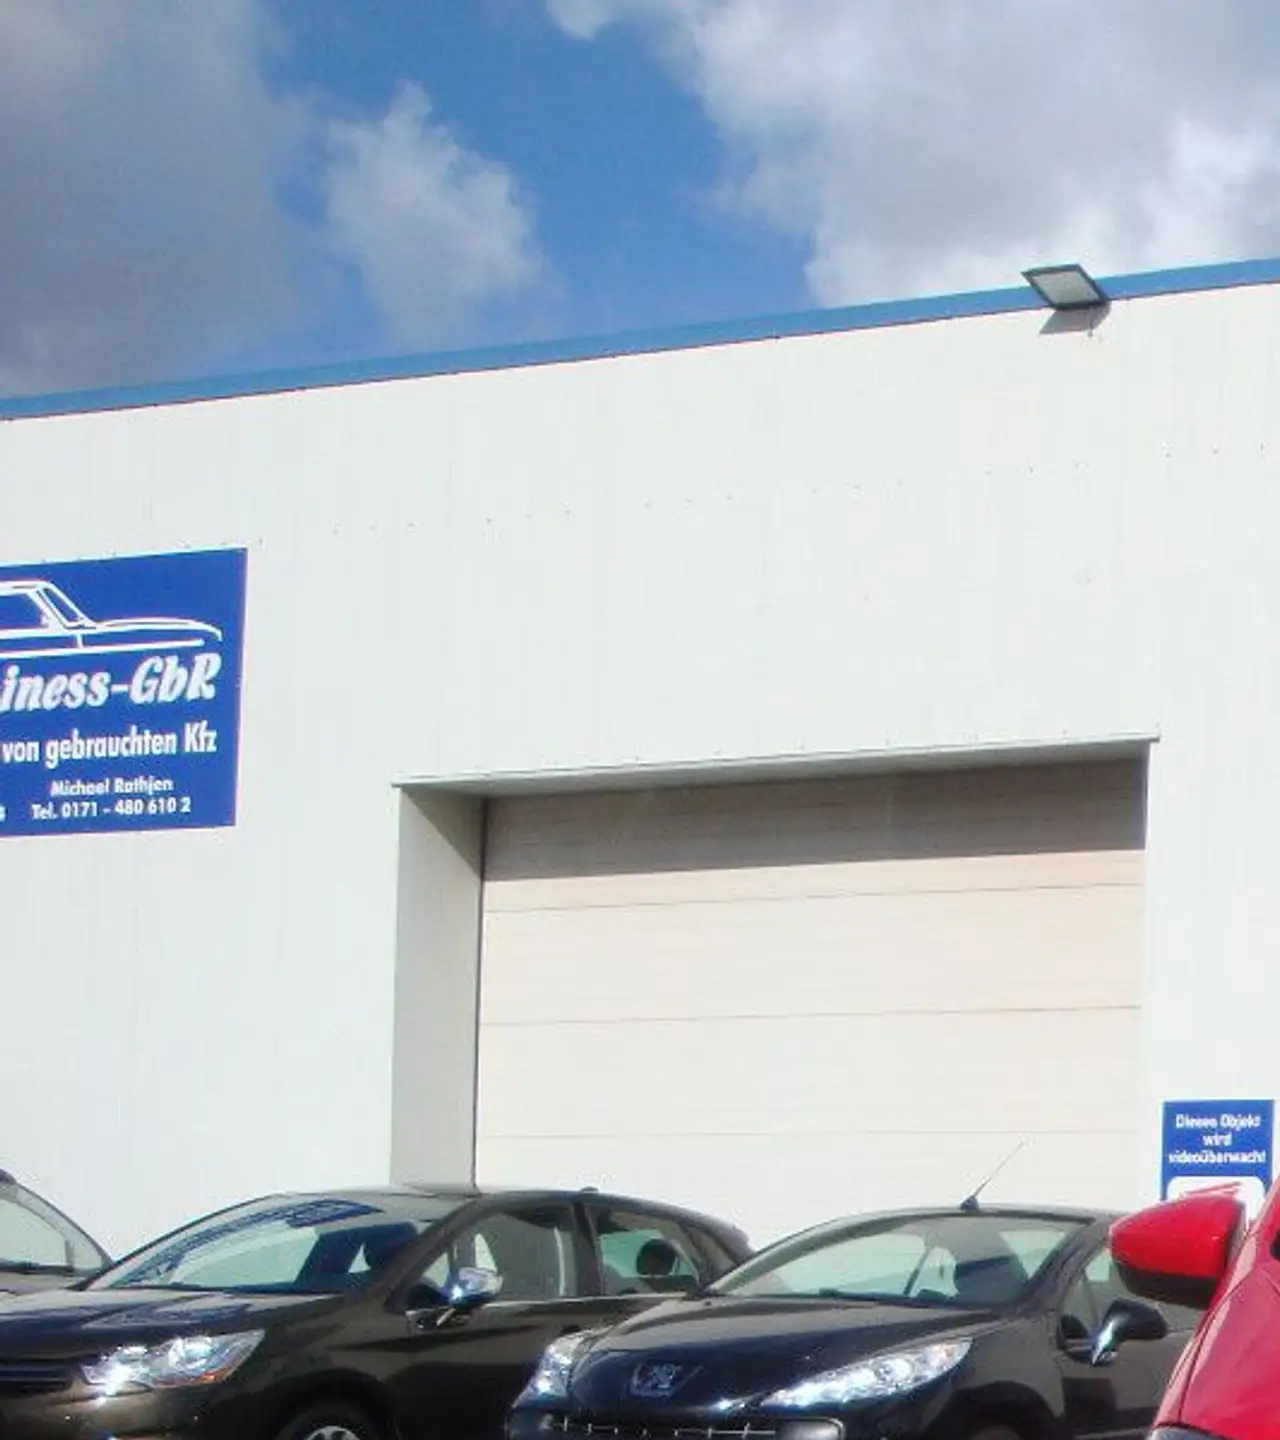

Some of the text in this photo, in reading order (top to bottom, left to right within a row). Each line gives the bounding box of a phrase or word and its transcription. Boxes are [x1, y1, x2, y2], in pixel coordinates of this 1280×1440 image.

[0, 652, 222, 712] iness-GbR
[2, 720, 218, 769] von gebrauchten Kfz
[31, 802, 58, 820] Tel.
[61, 801, 98, 818] 0171
[114, 799, 145, 815] 480
[146, 798, 178, 814] 610
[180, 797, 191, 812] 2
[1202, 1132, 1232, 1147] wird
